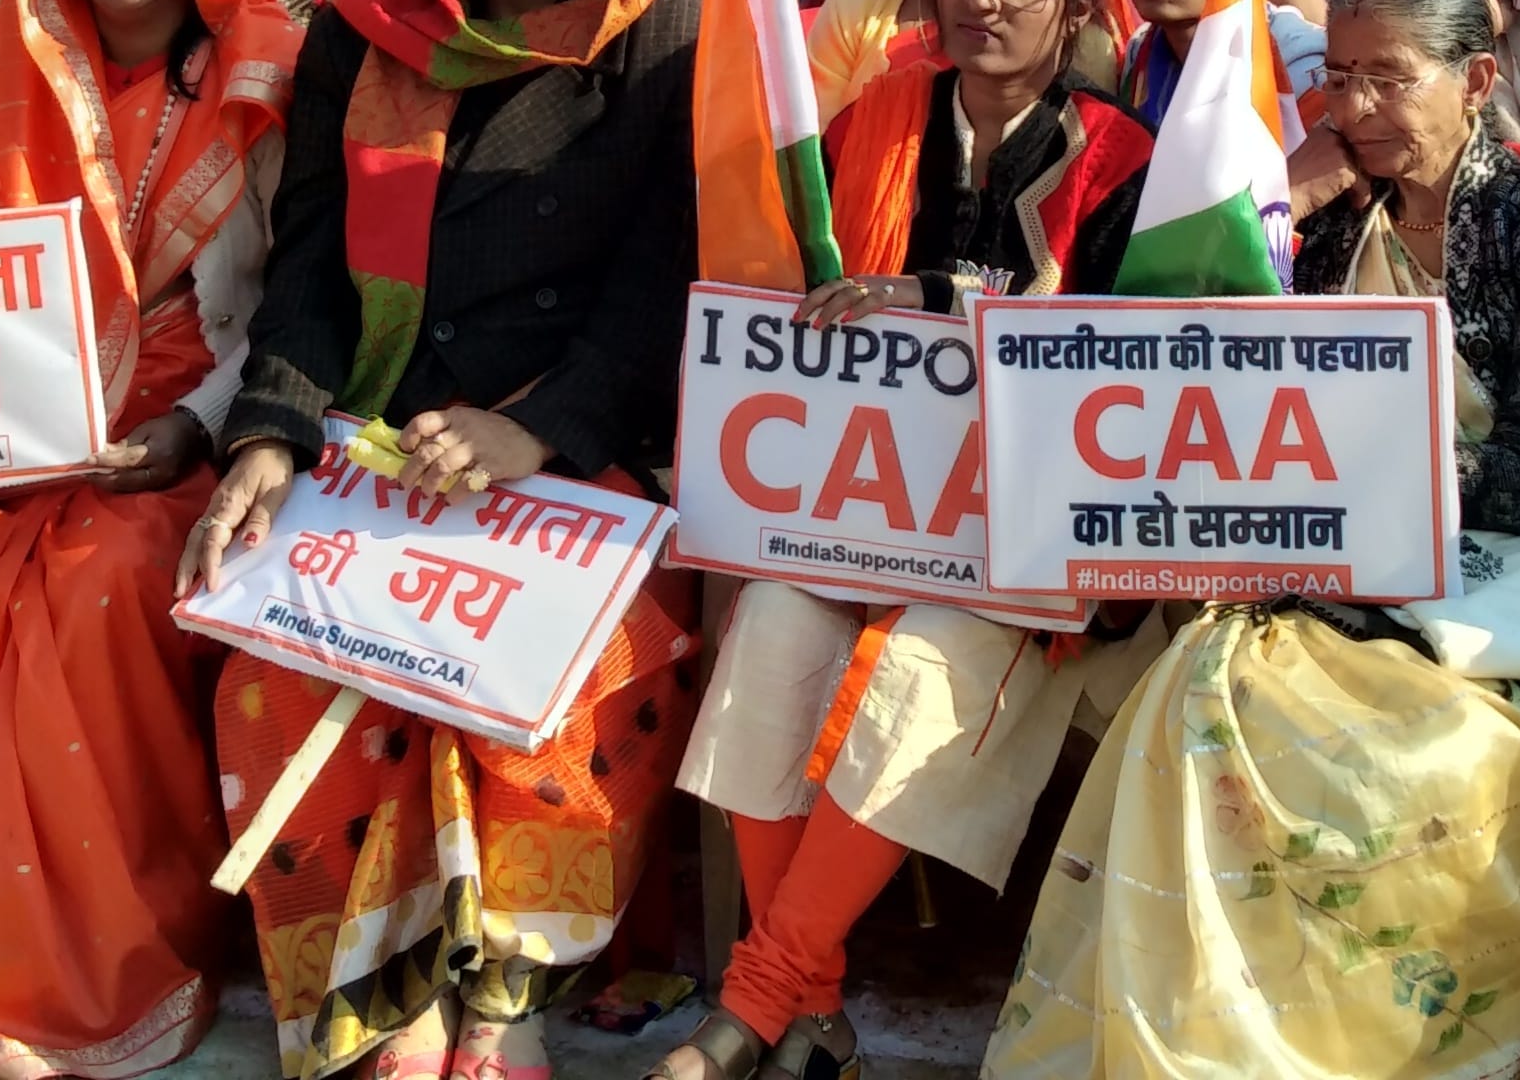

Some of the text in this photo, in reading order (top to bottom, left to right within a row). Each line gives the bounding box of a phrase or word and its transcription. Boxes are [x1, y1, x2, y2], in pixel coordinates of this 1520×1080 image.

[700, 308, 978, 395] I SUPPO
[998, 323, 1412, 372] भारतीयता की क्या पहचान
[719, 392, 987, 537] CAA
[1073, 385, 1339, 482] CAA
[476, 486, 627, 569] माता
[768, 536, 977, 583] #IndiaSupportsCAA
[1069, 491, 1347, 550] का हो सम्मान
[289, 528, 524, 641] की जय
[1077, 567, 1344, 597] #IndiaSupportsCAA
[264, 604, 465, 688] #IndiaSupportsCAA
